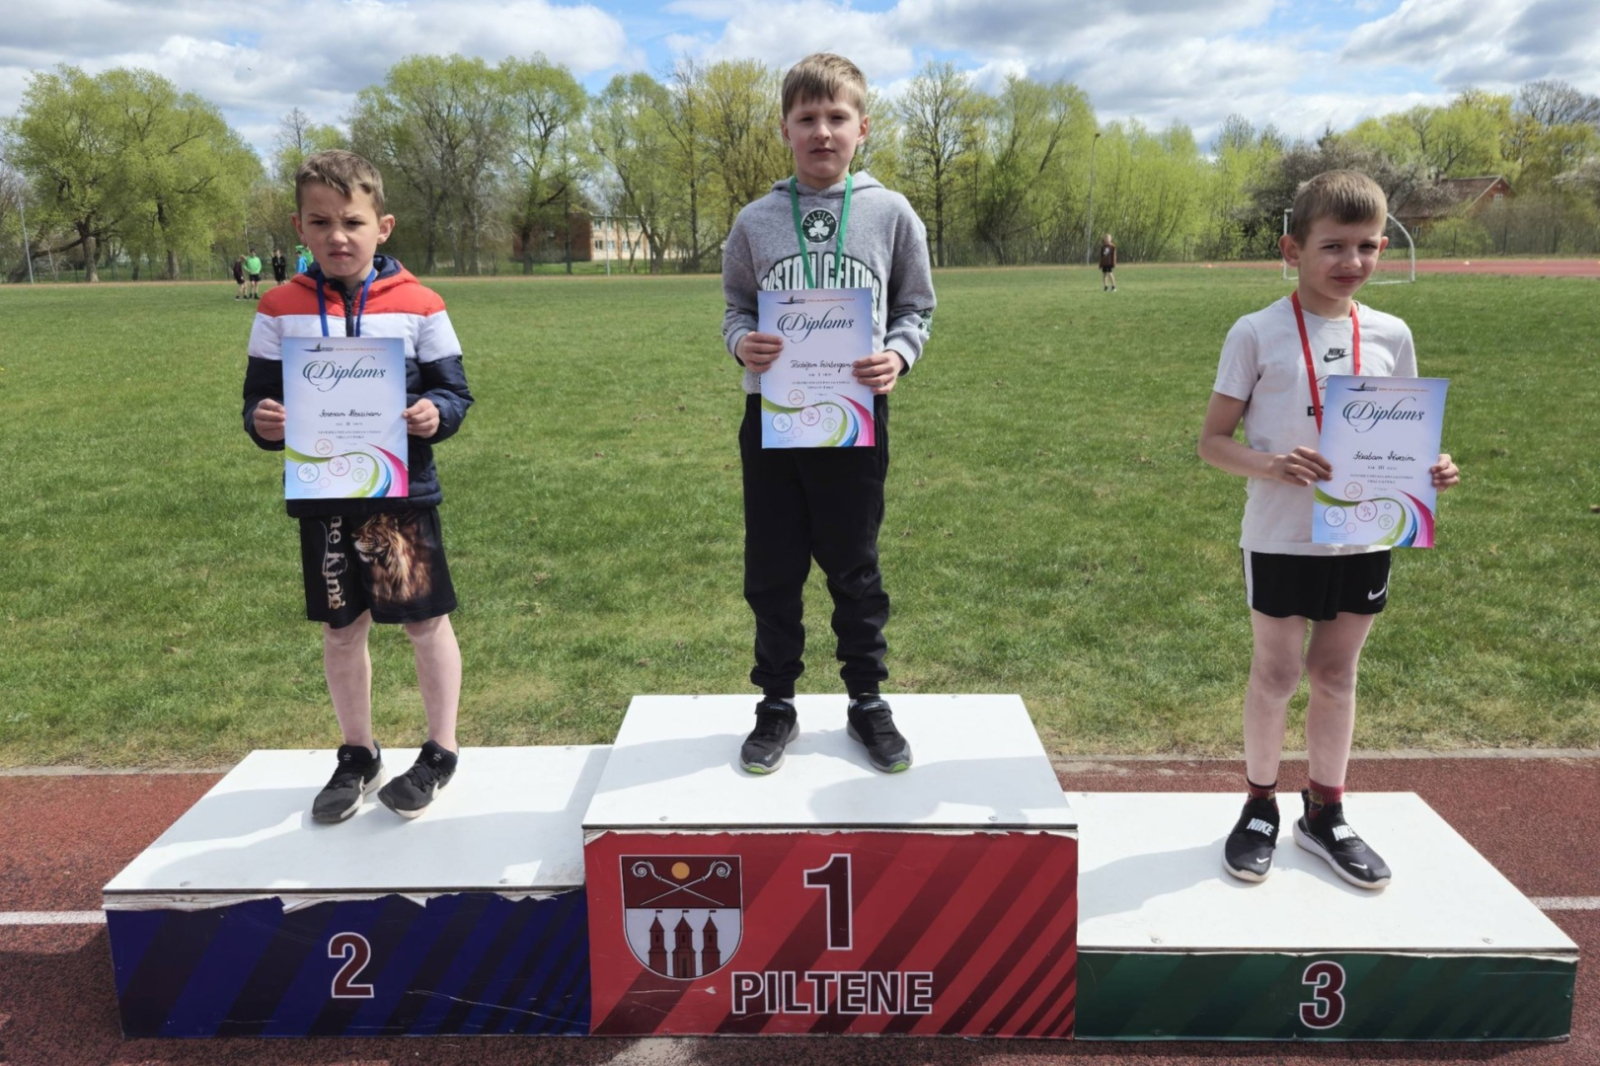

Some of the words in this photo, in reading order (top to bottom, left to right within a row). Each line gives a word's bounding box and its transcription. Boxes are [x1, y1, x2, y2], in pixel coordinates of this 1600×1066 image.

[804, 211, 834, 227] CELTICS
[777, 305, 855, 344] Diploms
[1327, 347, 1347, 356] NIKE
[302, 355, 387, 392] Diploms
[1342, 396, 1425, 434] Diploms
[1246, 817, 1275, 837] NIKE
[1332, 824, 1356, 841] NIKE
[803, 853, 852, 951] 1
[328, 931, 375, 998] 2
[731, 971, 933, 1014] PILTENE
[1299, 960, 1346, 1030] 3
